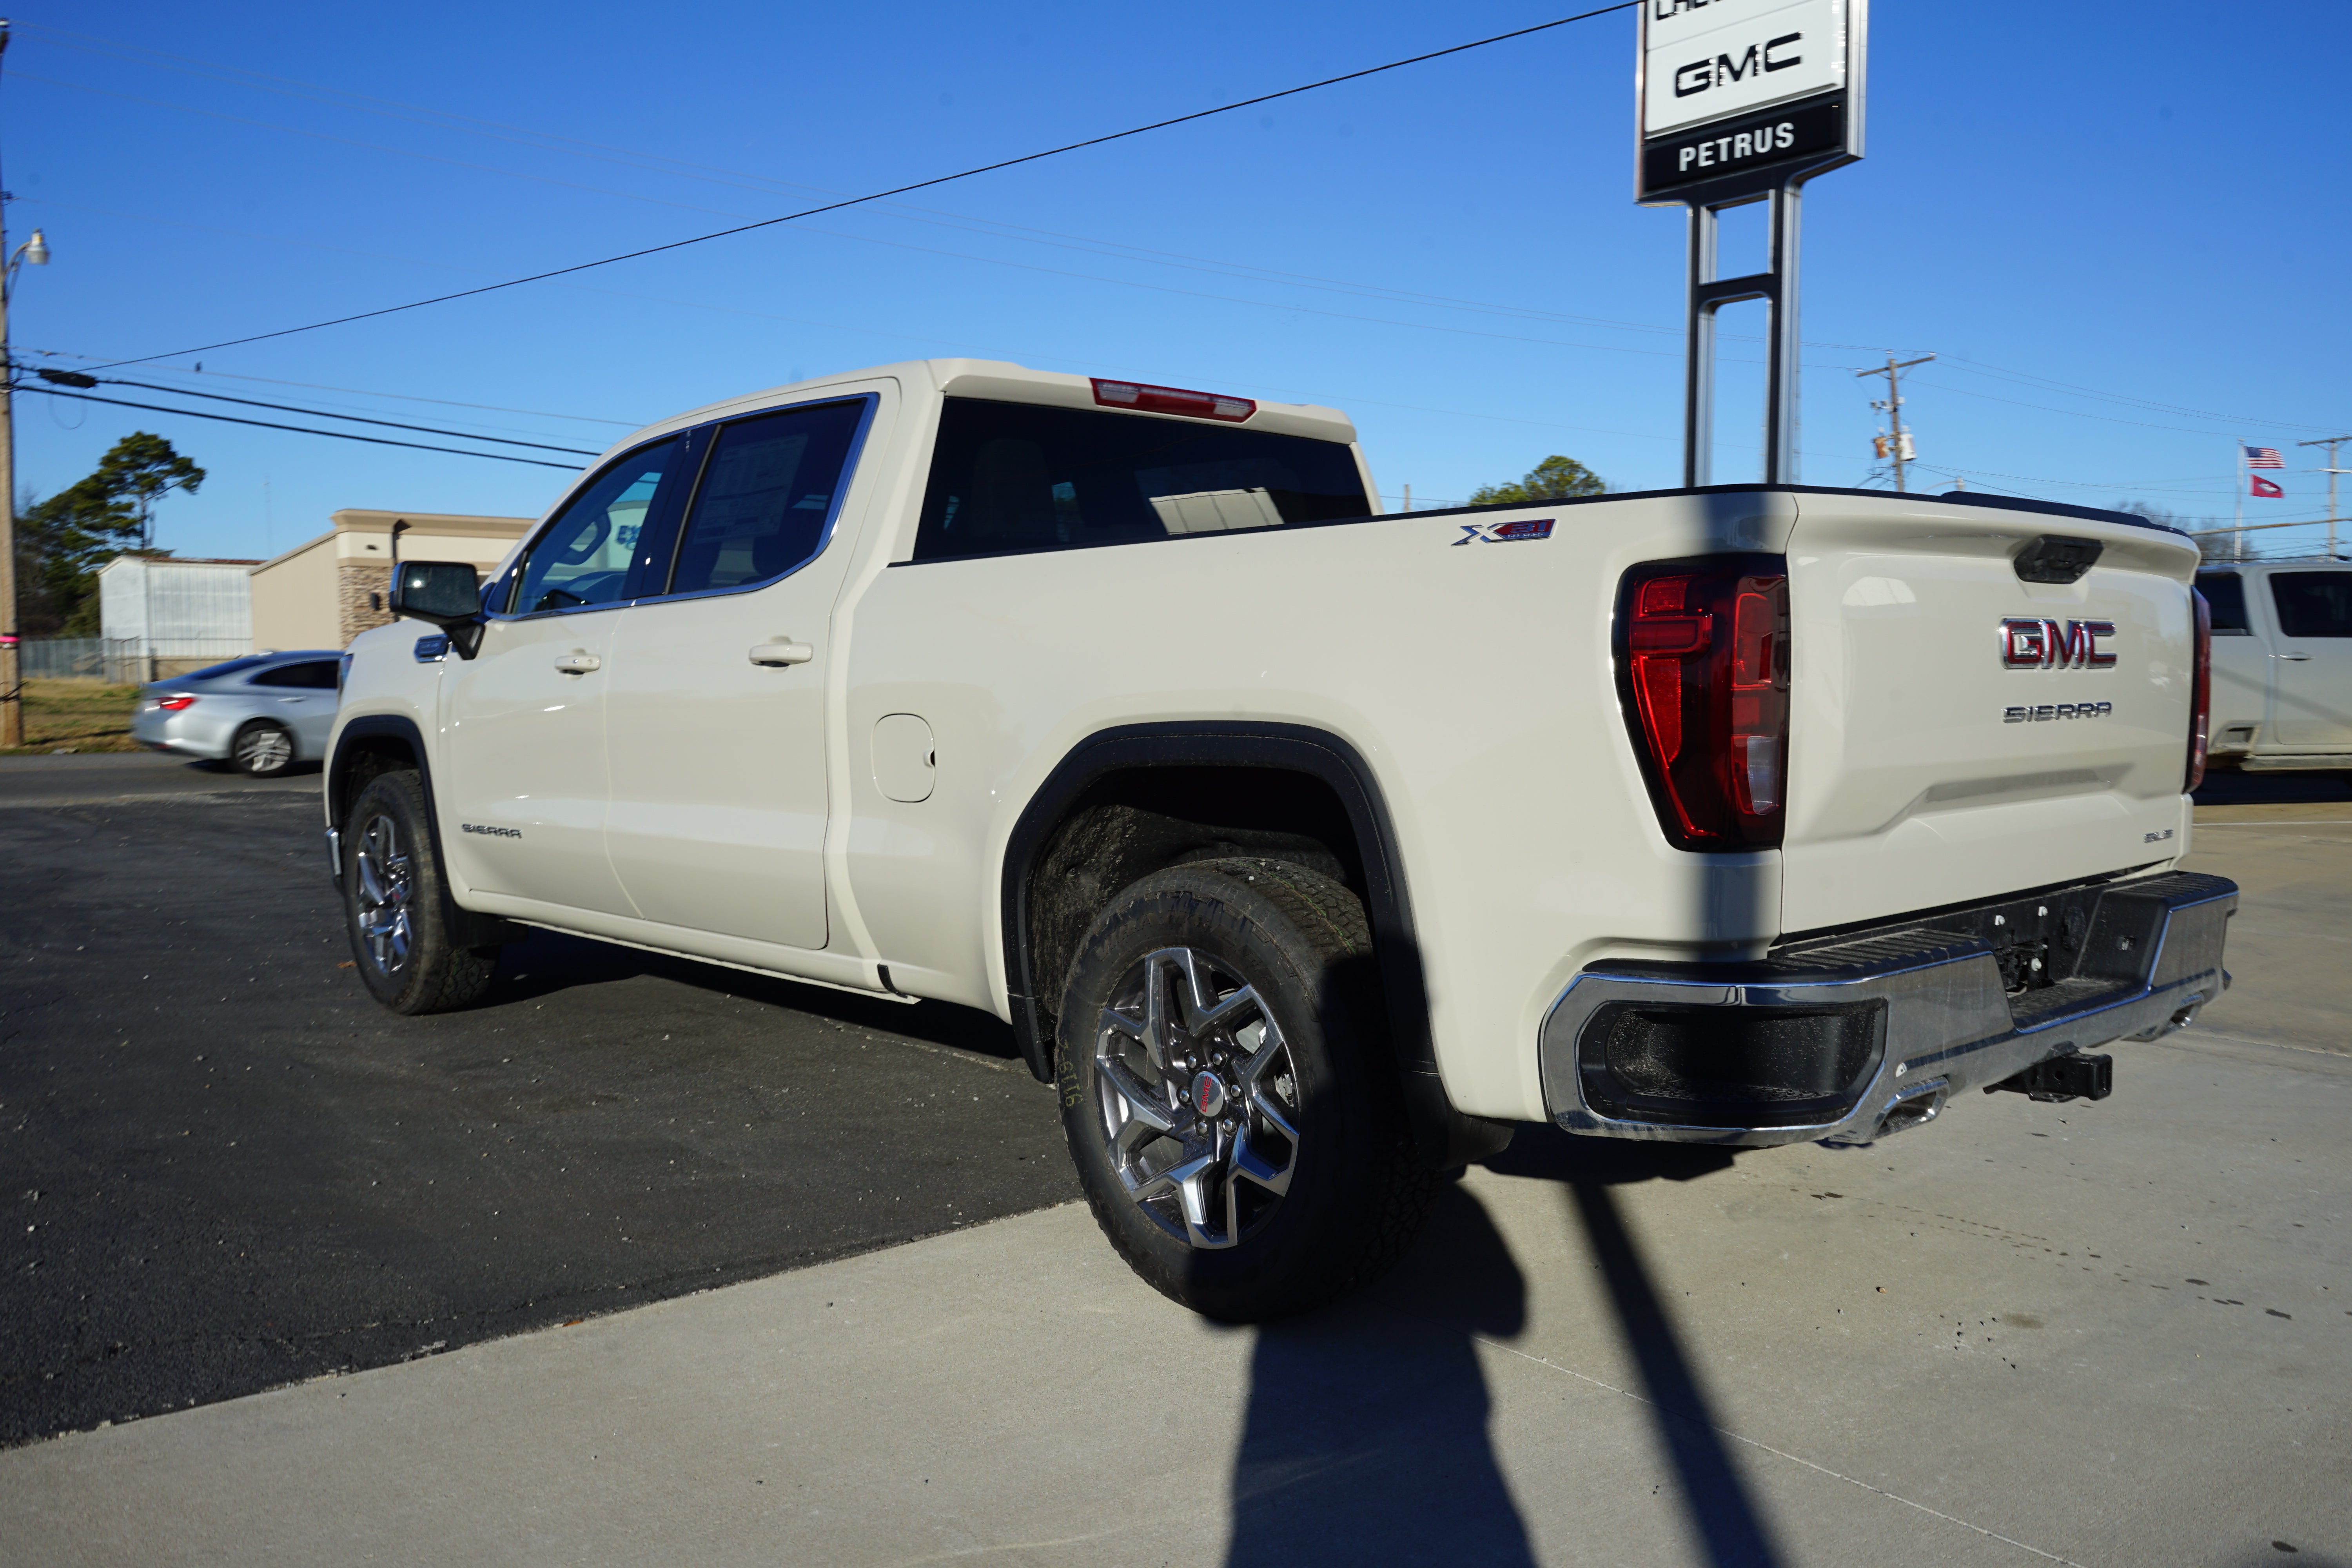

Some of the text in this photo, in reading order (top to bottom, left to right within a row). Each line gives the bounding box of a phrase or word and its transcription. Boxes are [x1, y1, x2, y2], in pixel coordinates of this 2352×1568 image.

[1675, 31, 1805, 98] GMC
[1679, 122, 1794, 171] PETRUS
[2001, 617, 2118, 669] GMC
[2001, 702, 2112, 723] SIERRA
[1201, 1075, 1212, 1112] GMC
